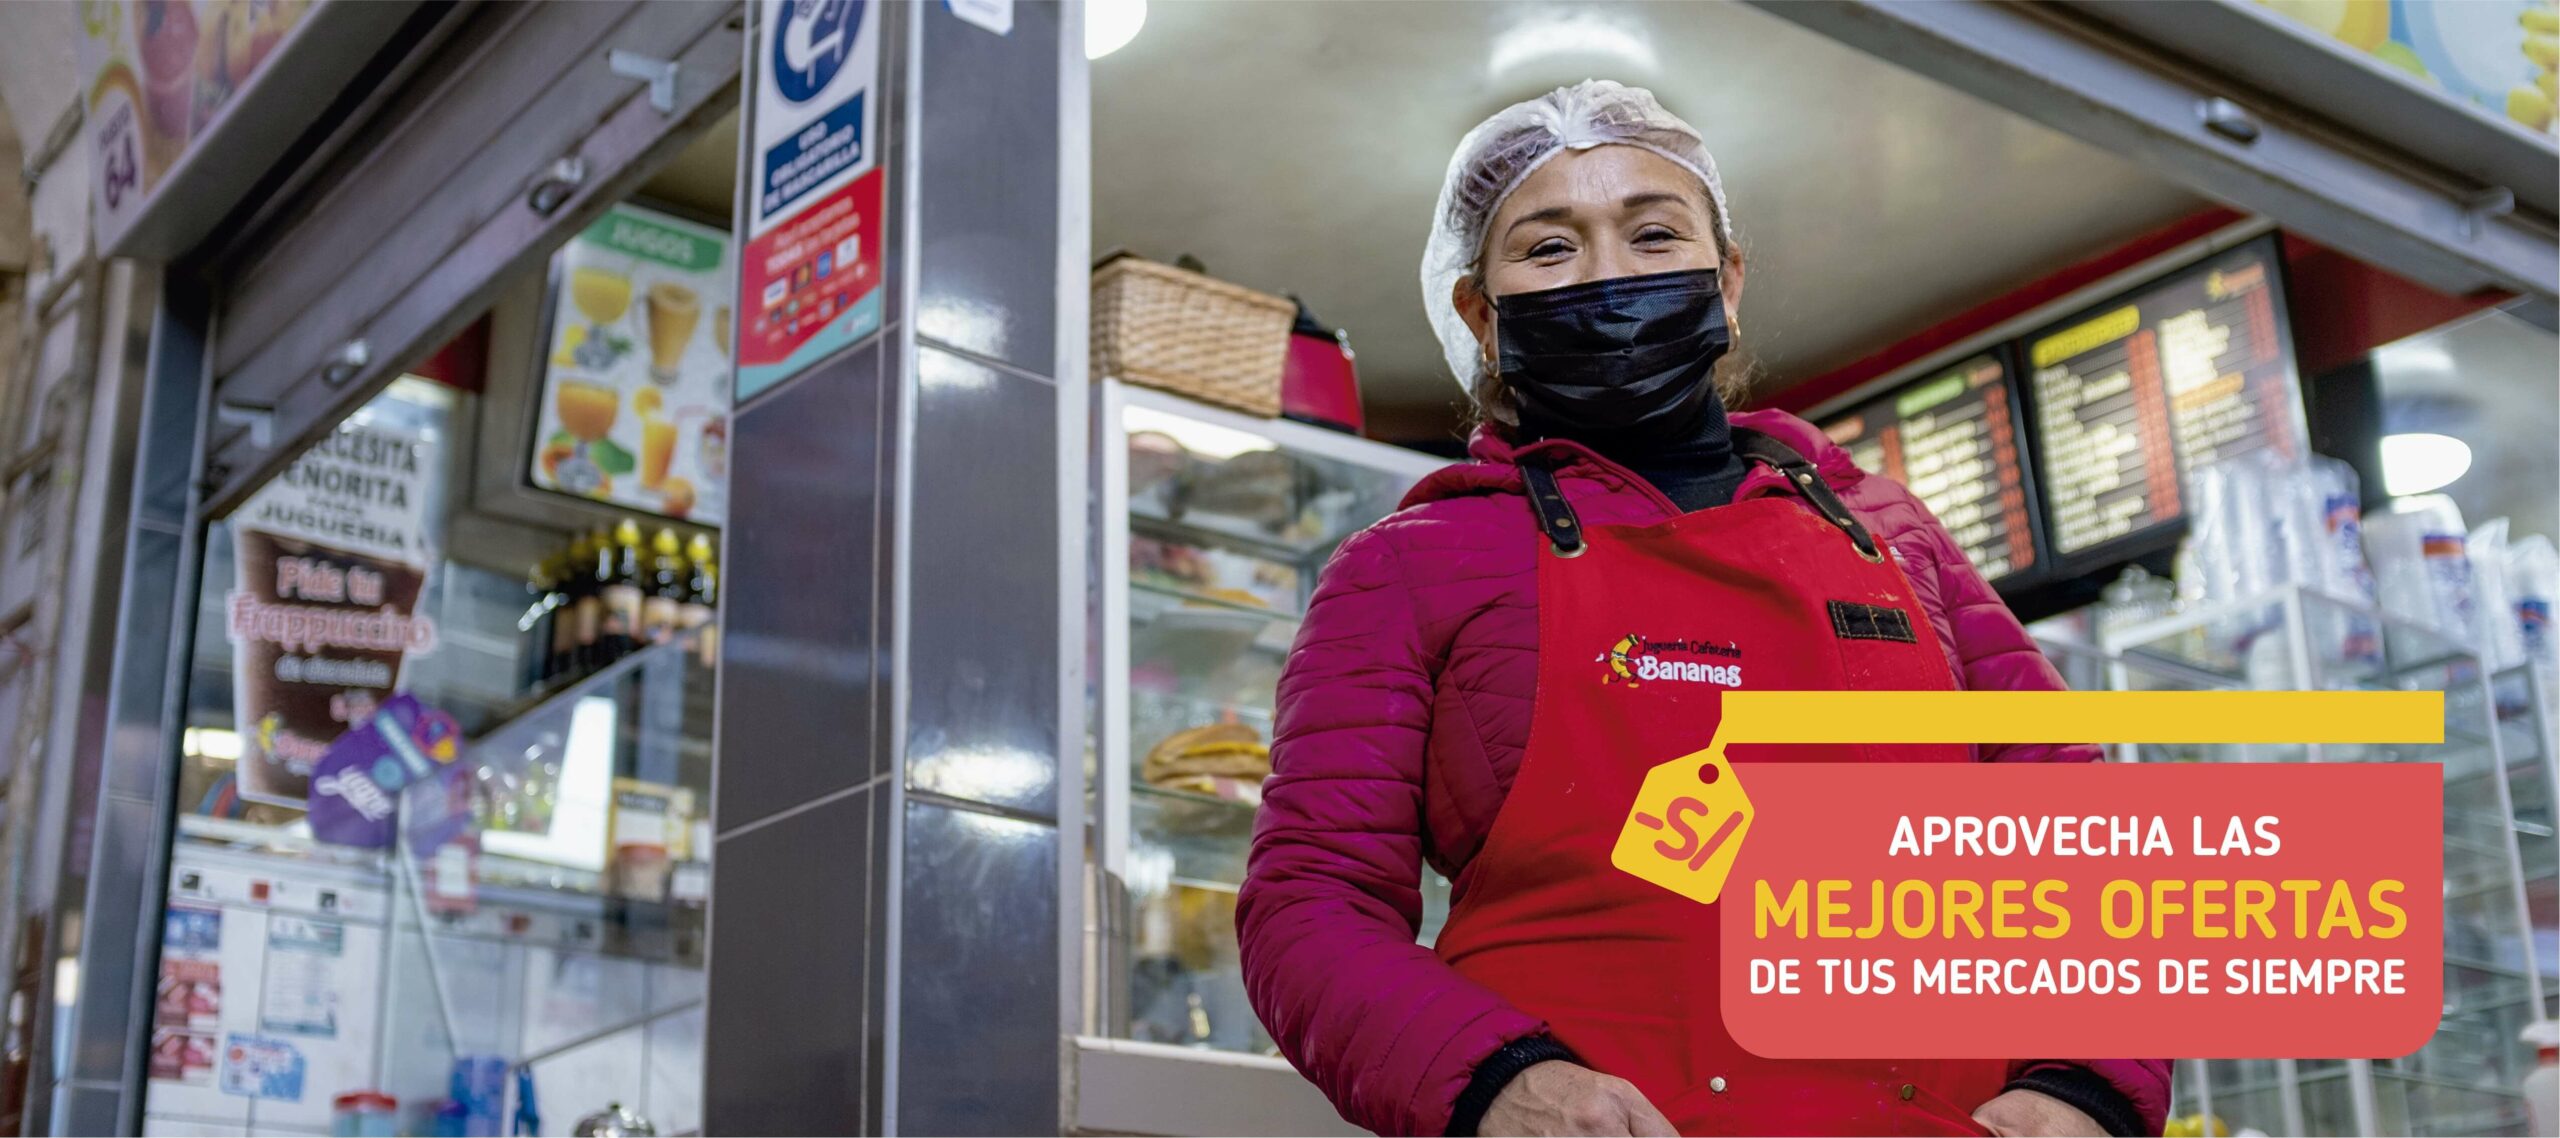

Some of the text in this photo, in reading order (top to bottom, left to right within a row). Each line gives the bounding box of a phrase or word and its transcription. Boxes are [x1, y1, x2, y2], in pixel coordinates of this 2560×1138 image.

[798, 121, 828, 150] USO
[104, 133, 136, 209] 64
[611, 221, 695, 265] JUGOS
[311, 427, 416, 474] ECESITA
[1637, 655, 1742, 688] Bananas
